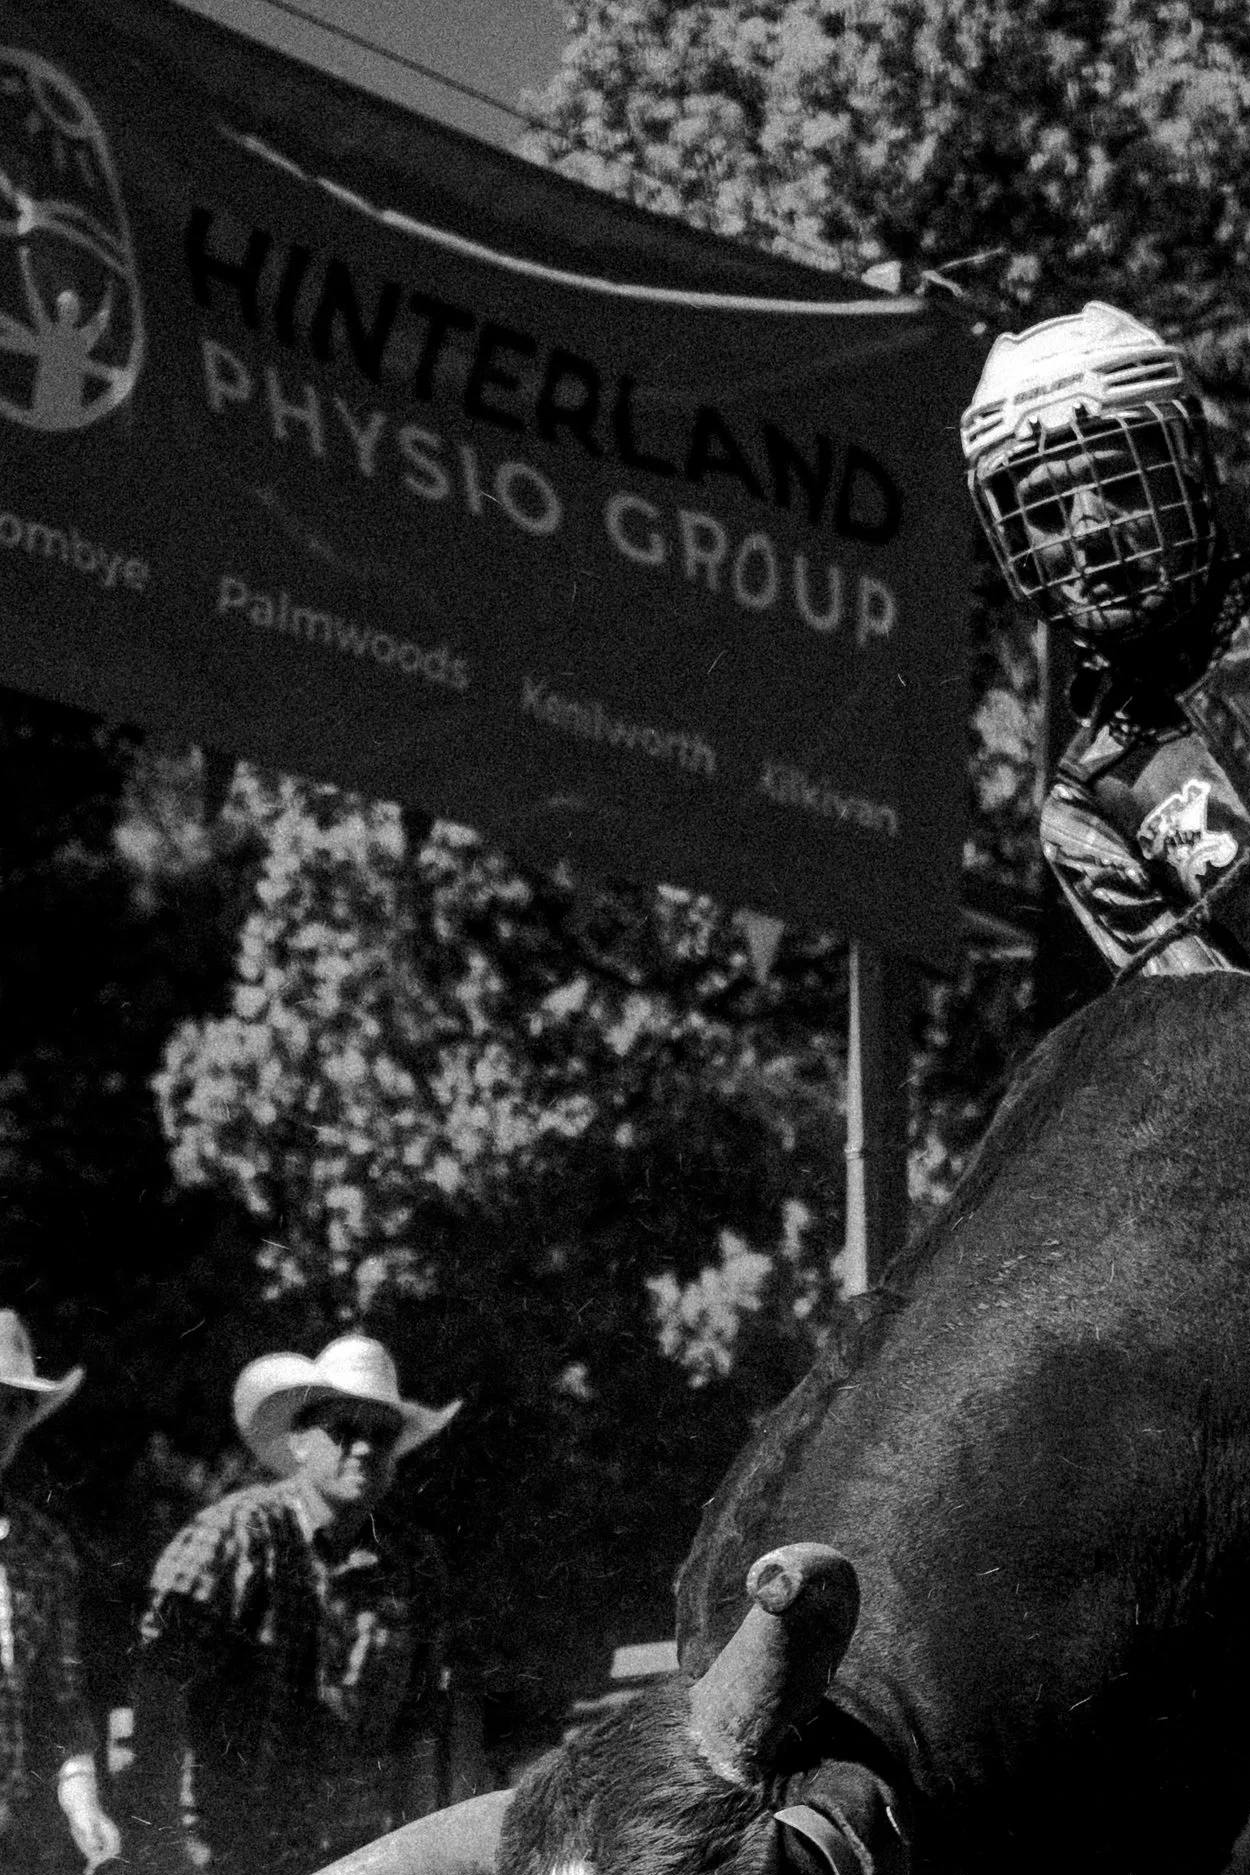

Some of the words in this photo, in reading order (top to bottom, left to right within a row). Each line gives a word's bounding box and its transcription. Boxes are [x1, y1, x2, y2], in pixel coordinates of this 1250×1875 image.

[187, 208, 903, 547] HINTERLAND
[199, 336, 563, 537] PHYSIO
[604, 491, 898, 648] GROUP
[217, 574, 470, 691] Palmwoods
